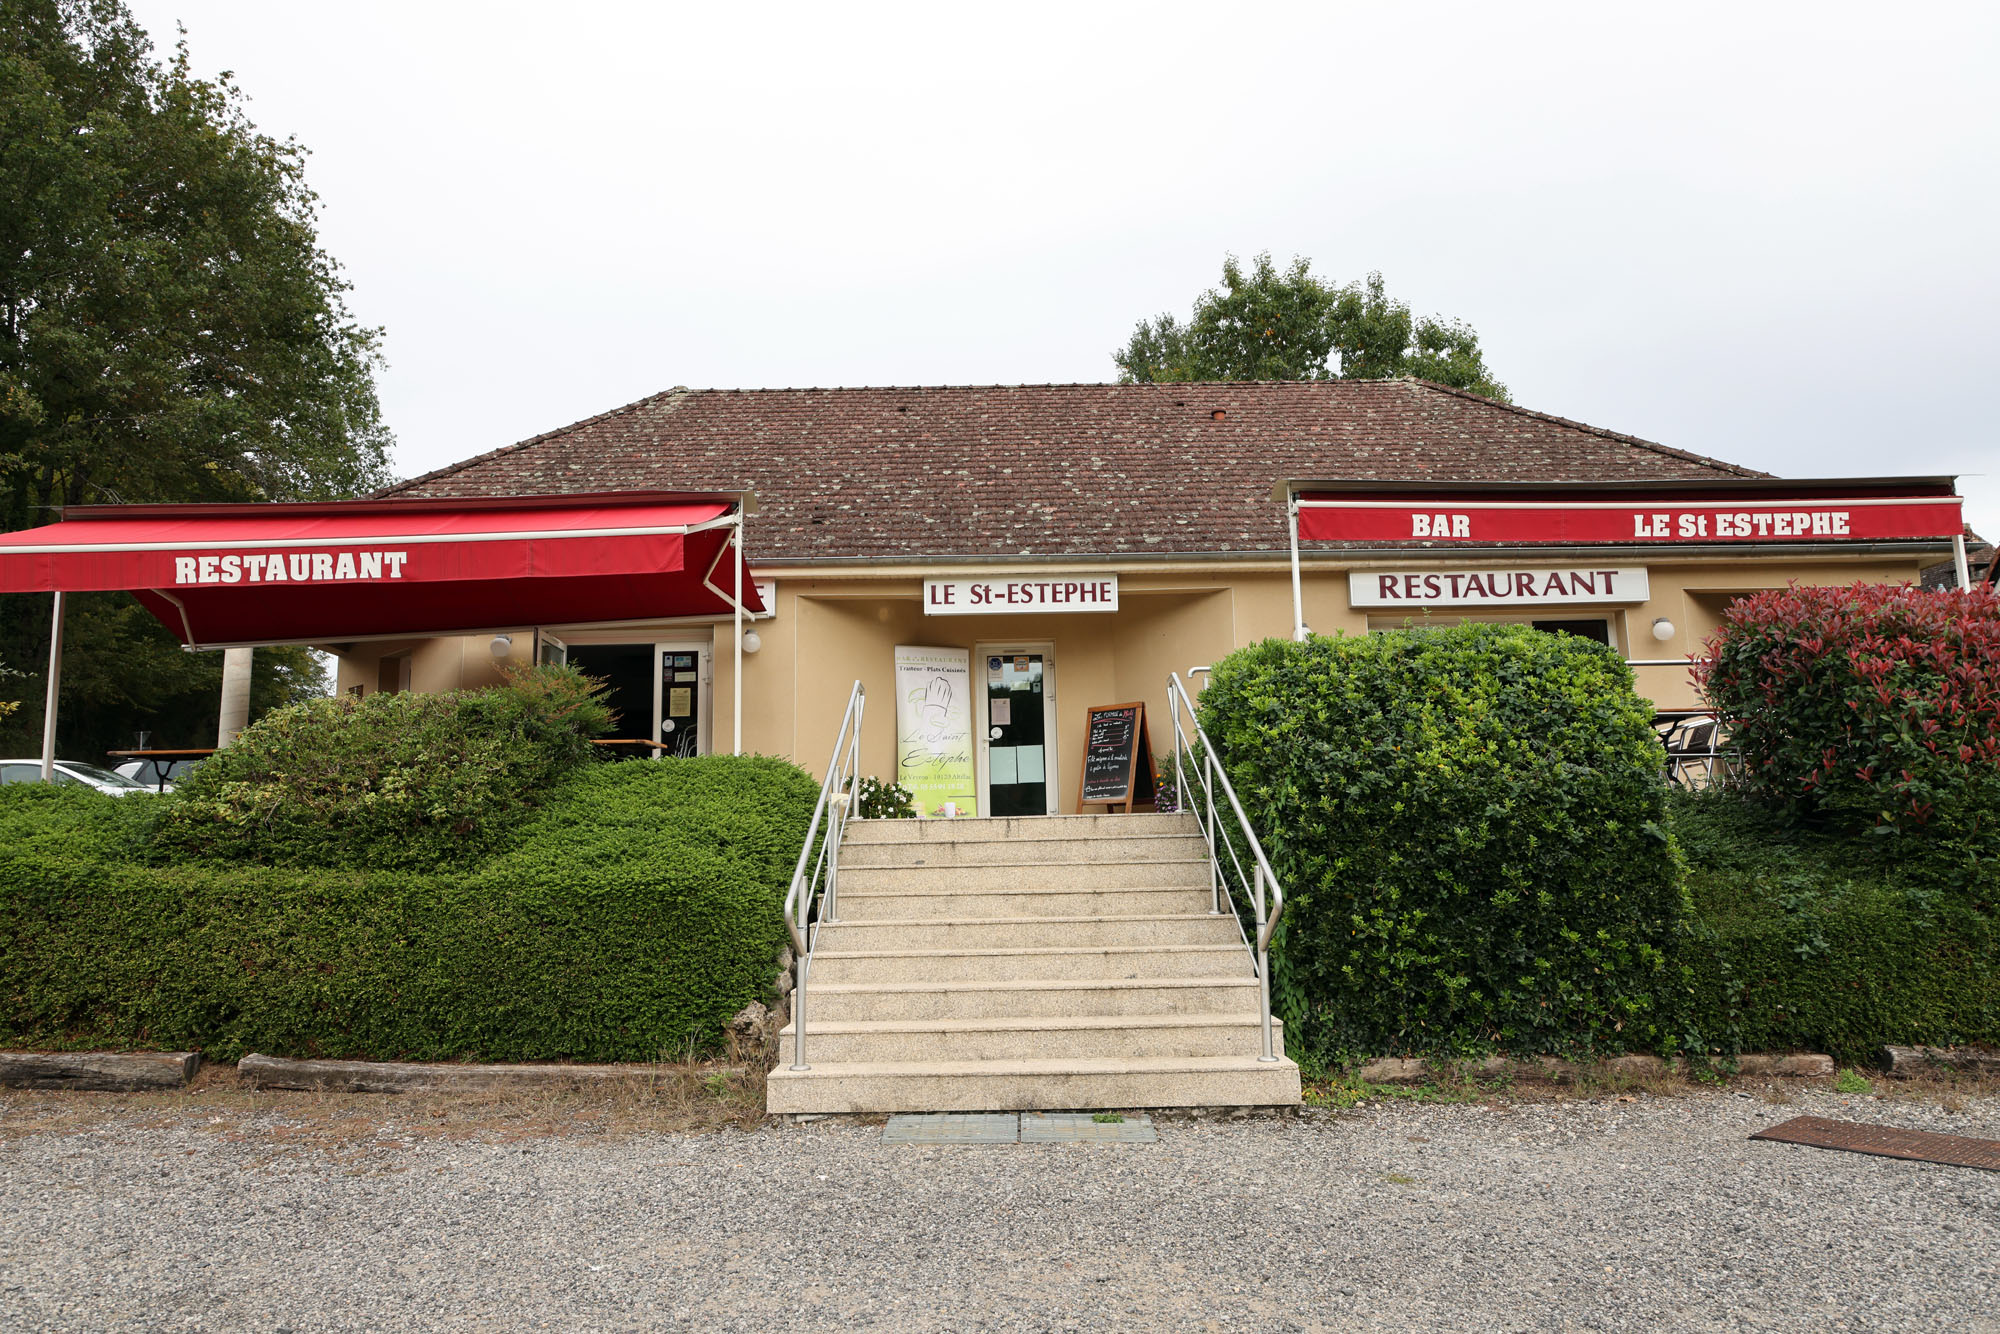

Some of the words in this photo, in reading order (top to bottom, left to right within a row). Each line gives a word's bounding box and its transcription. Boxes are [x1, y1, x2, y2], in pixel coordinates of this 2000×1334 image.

[1411, 513, 1470, 538] BAR
[1633, 514, 1671, 537] LE
[1678, 513, 1708, 538] St
[1715, 512, 1850, 537] ESTEPHE
[175, 551, 407, 584] RESTAURANT
[930, 584, 956, 605] LE
[970, 582, 1112, 605] St-ESTEPHE
[1378, 570, 1619, 600] RESTAURANT
[900, 728, 924, 743] Le
